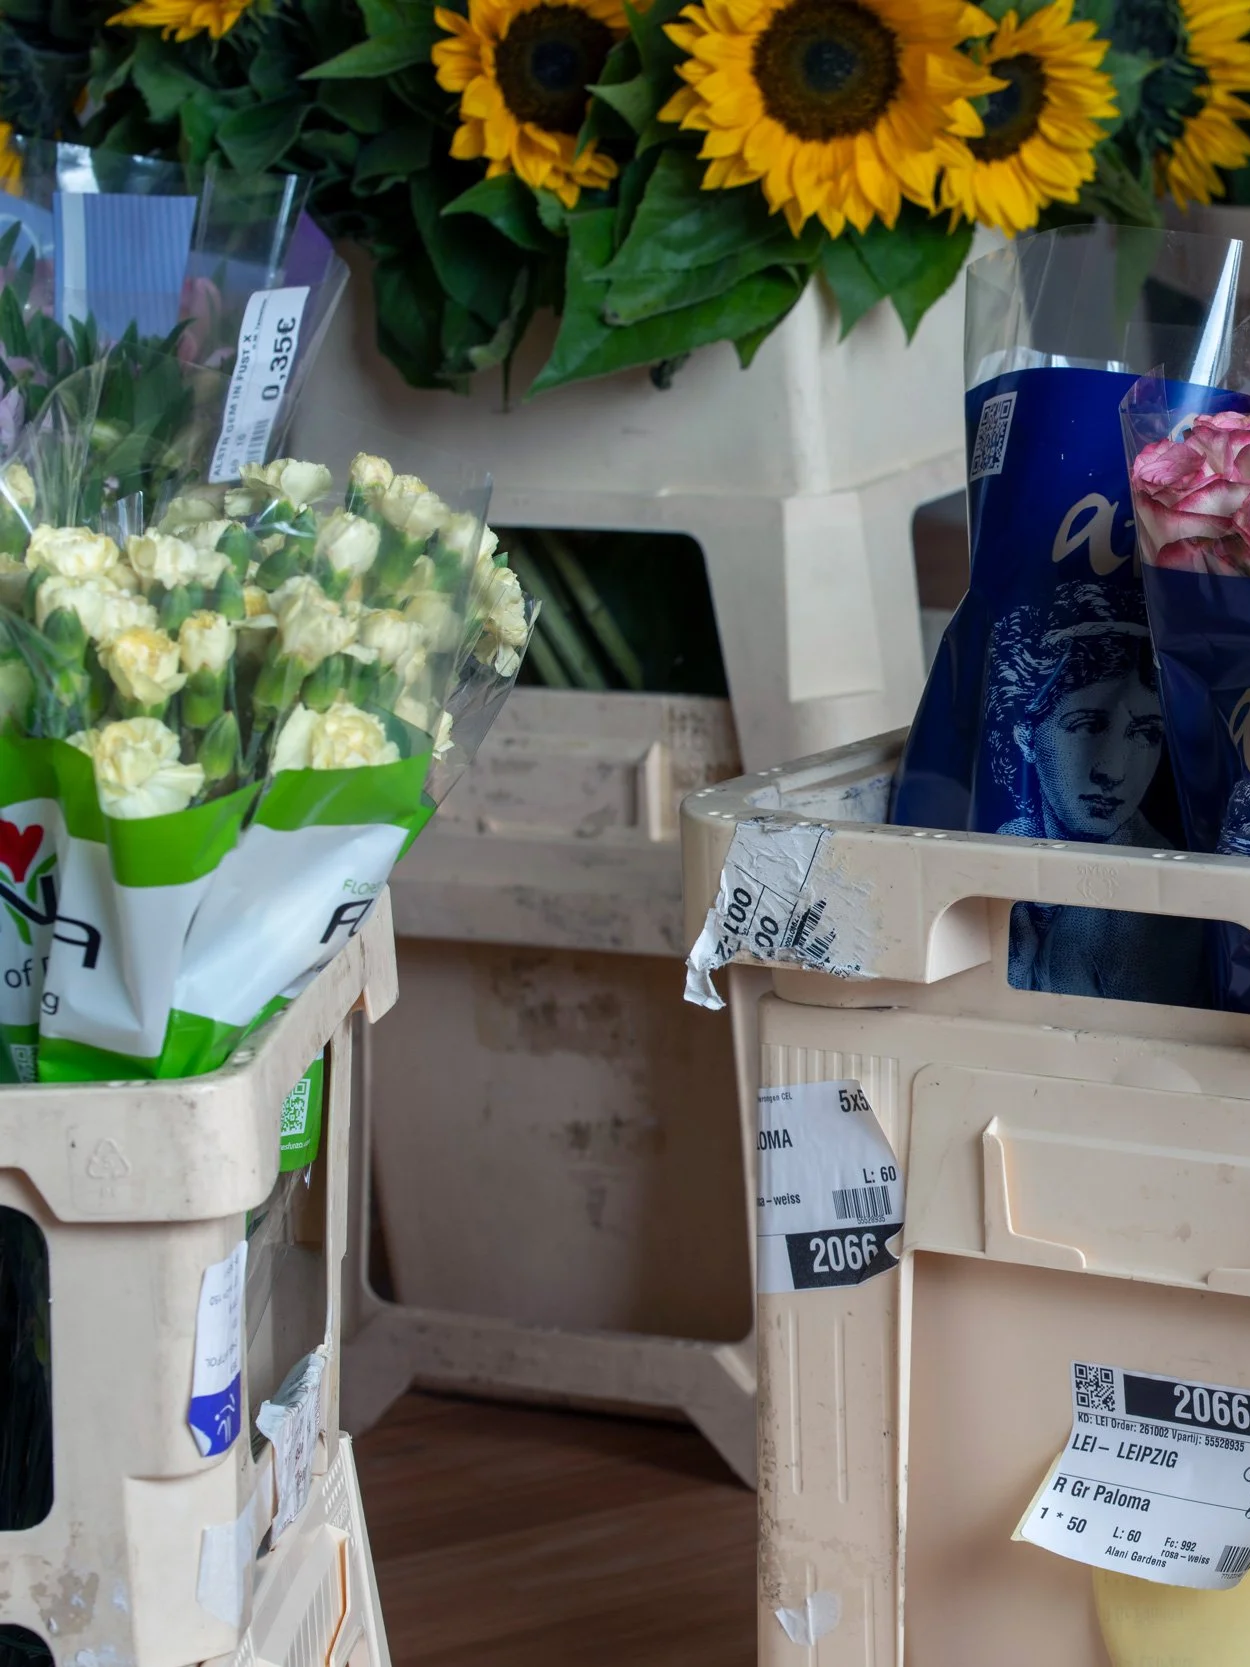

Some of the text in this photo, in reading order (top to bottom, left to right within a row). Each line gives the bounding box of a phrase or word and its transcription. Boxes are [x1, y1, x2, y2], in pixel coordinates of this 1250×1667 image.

[236, 350, 251, 381] FUST
[261, 316, 297, 402] 0,35€
[232, 384, 242, 401] IN
[4, 958, 33, 989] of
[862, 1165, 897, 1184] L: 60
[1173, 1384, 1250, 1430] 2066
[1077, 1411, 1246, 1453] KD: LEI Order: 261002 Vpartij: 55528935
[1116, 1441, 1179, 1469] LEIPZIG
[1052, 1475, 1152, 1513] R Gr Paloma
[1038, 1506, 1088, 1535] 1 50
[1112, 1525, 1142, 1544] L: 60
[1105, 1545, 1168, 1569] Alani Gardens
[1164, 1536, 1198, 1553] Fc: 992
